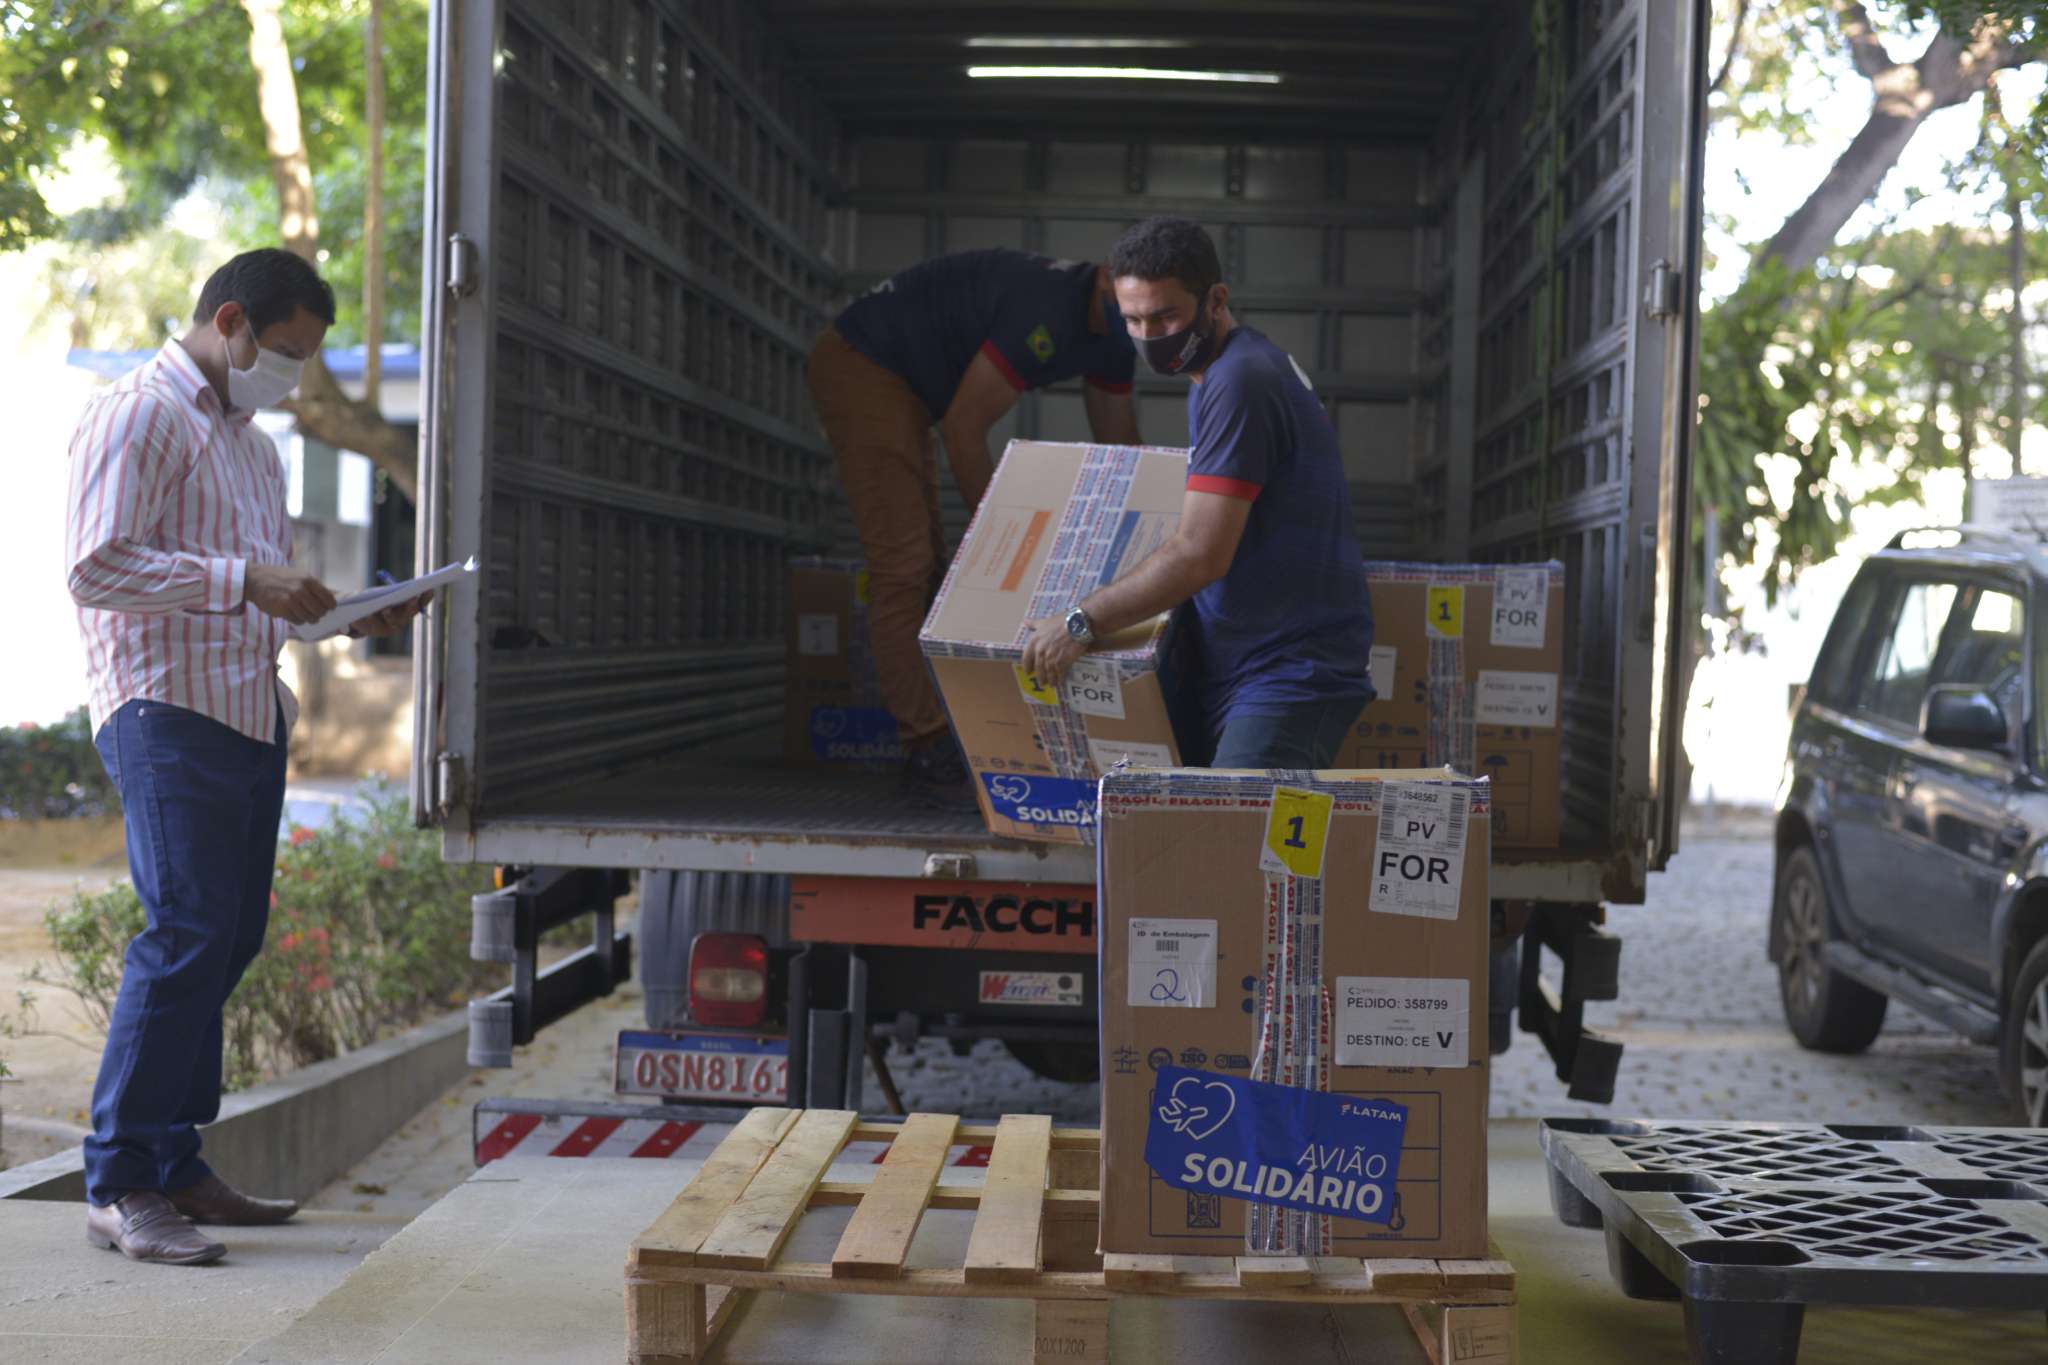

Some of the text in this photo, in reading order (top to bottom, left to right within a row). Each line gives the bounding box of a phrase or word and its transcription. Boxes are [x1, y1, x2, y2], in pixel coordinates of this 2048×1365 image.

[1438, 601, 1451, 621] 1
[1495, 608, 1538, 627] FOR
[1029, 677, 1046, 692] 1
[1082, 672, 1100, 683] PV
[1071, 686, 1114, 703] FOR
[1016, 805, 1100, 825] SOLIDÁ
[1284, 816, 1306, 849] 1
[1406, 820, 1436, 839] PV
[1379, 851, 1450, 885] FOR
[1379, 883, 1389, 895] R
[913, 894, 1092, 937] FACCH
[1150, 968, 1186, 1002] 2
[1346, 997, 1448, 1010] PEDIDO: 358799
[1346, 1031, 1454, 1049] DESTINO: CE V
[1353, 1105, 1402, 1122] LATAM
[1296, 1143, 1388, 1179] AVIÃO
[1180, 1152, 1383, 1215] SOLIDÁRIO
